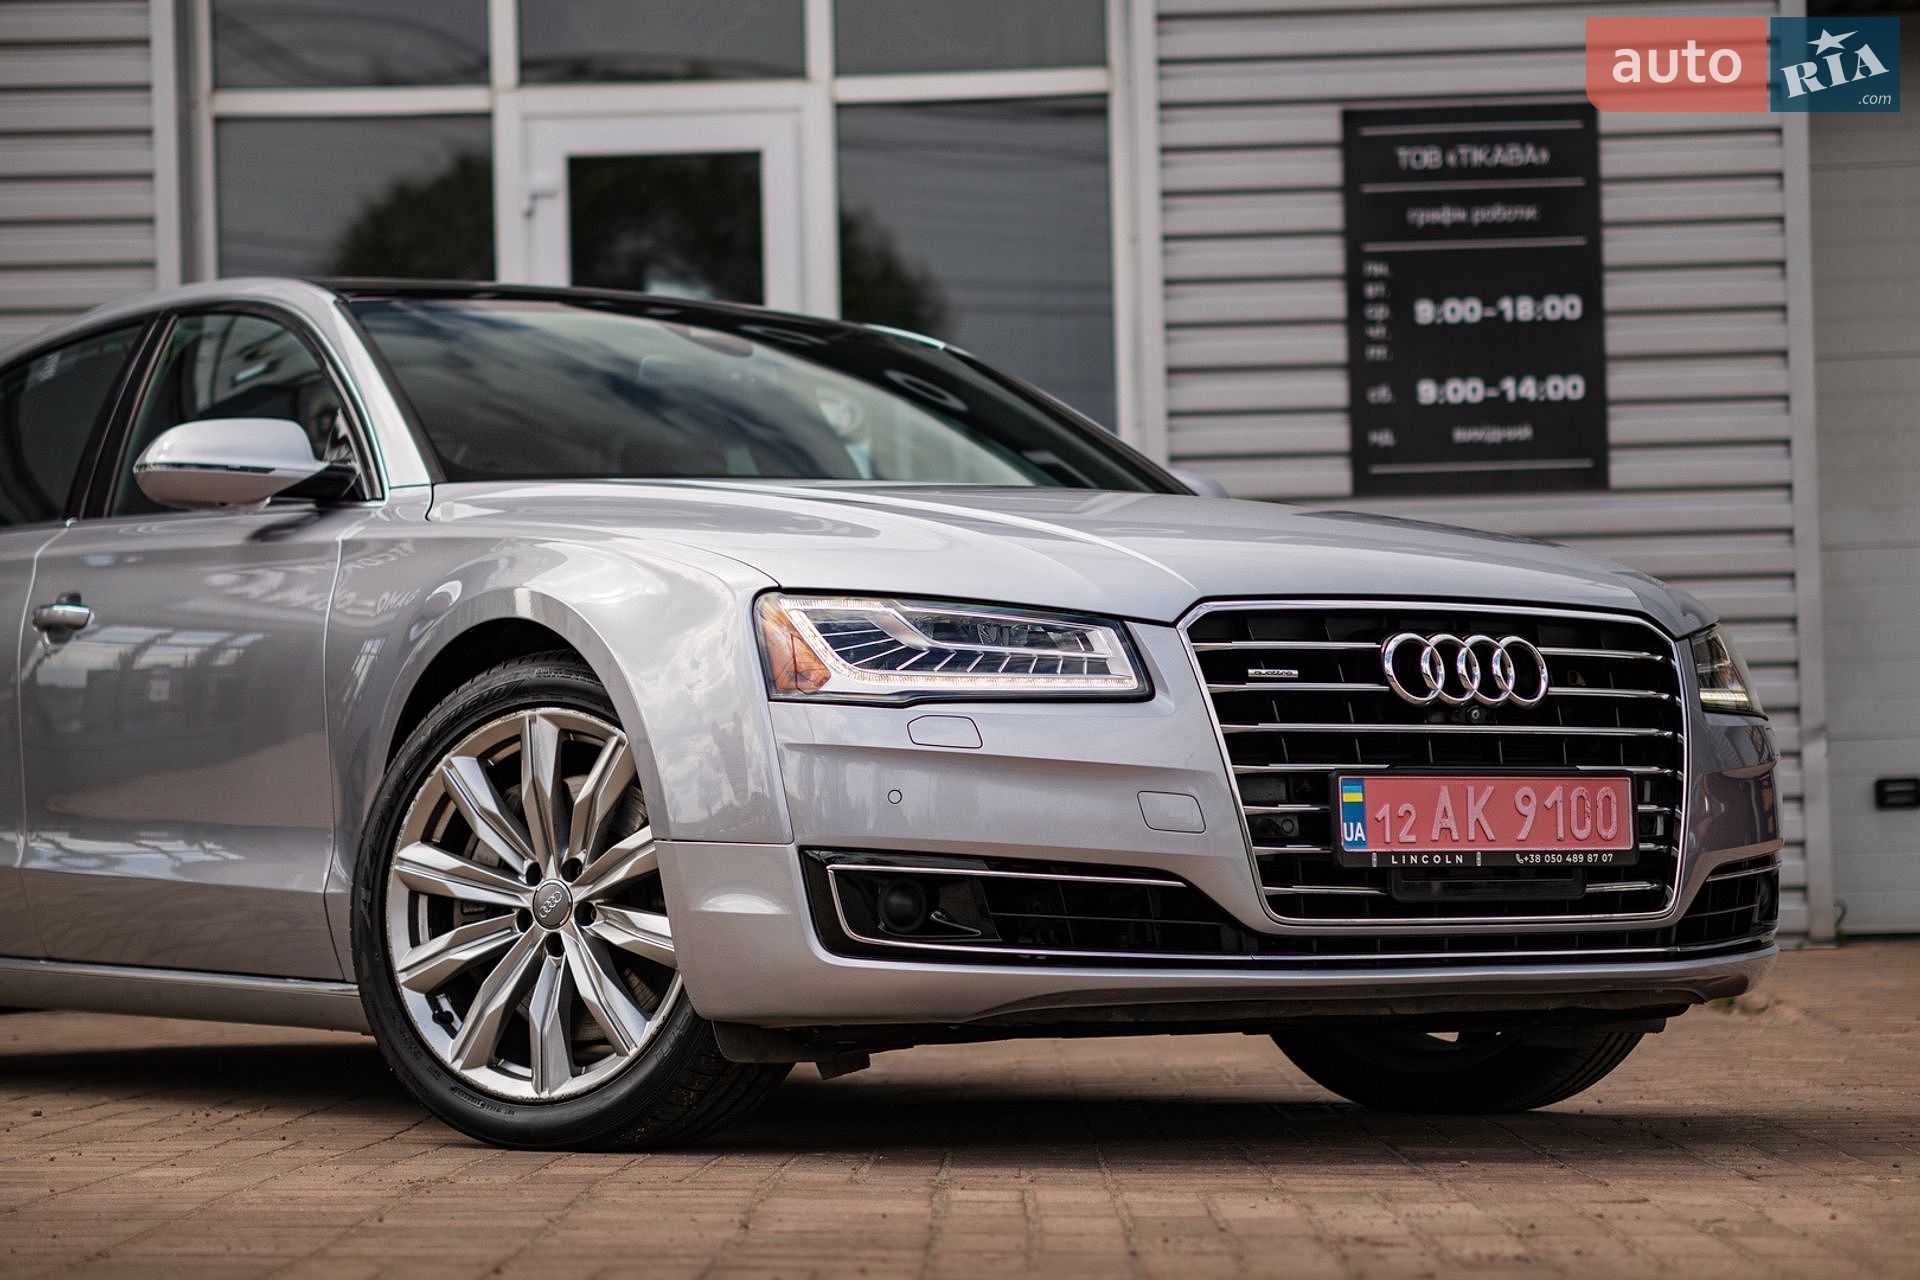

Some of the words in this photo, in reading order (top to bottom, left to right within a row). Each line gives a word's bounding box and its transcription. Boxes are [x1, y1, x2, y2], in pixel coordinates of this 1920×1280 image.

[1375, 803, 1417, 844] 12
[1431, 785, 1497, 842] AK
[1515, 786, 1617, 841] 9100
[1343, 822, 1366, 842] UA
[1391, 855, 1464, 865] LINCOLN
[1524, 854, 1541, 864] +38
[1544, 854, 1562, 864] 050
[1566, 854, 1584, 864] 489
[1587, 854, 1599, 864] 87
[1602, 853, 1613, 864] 07
